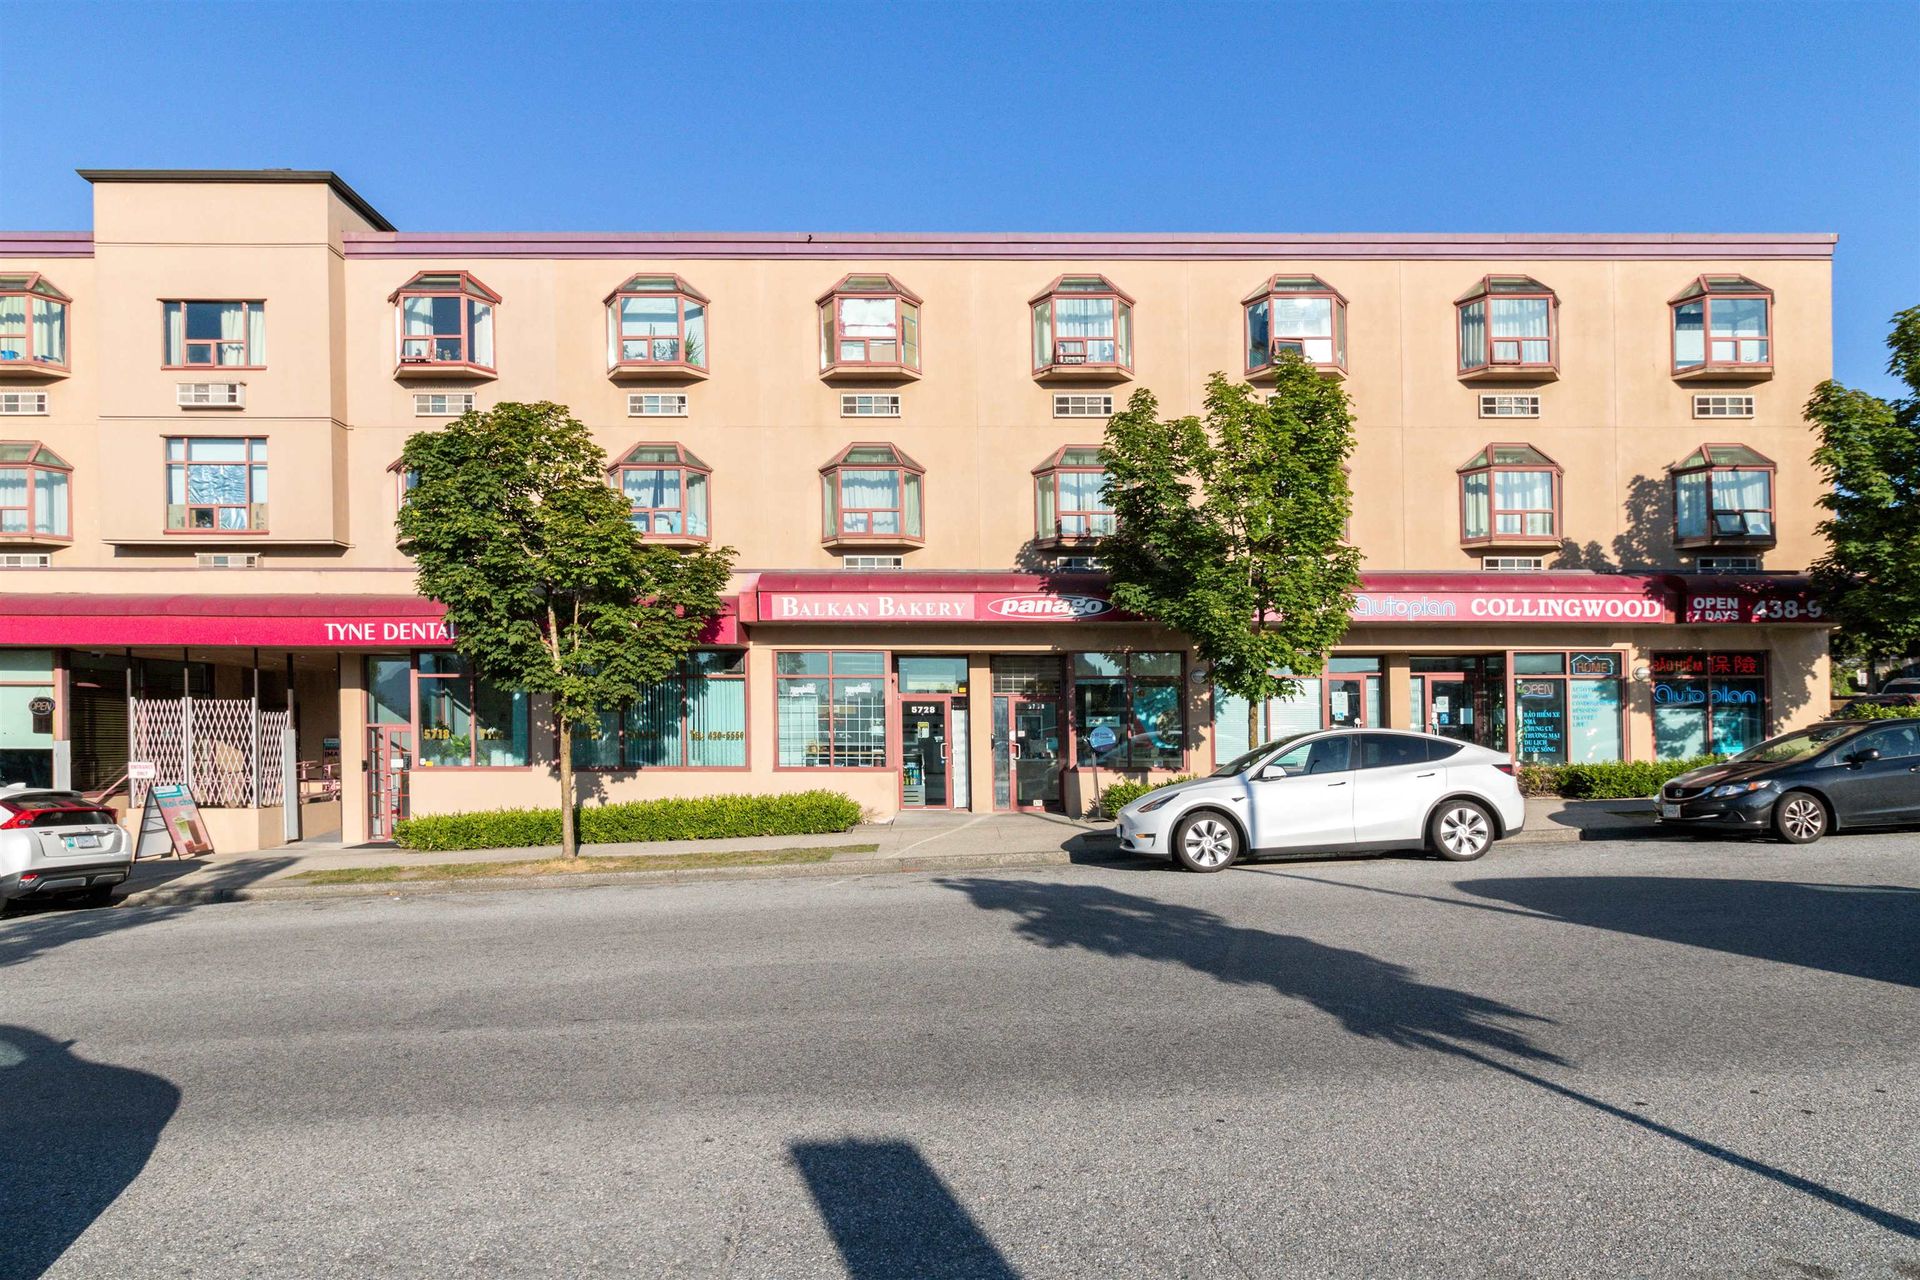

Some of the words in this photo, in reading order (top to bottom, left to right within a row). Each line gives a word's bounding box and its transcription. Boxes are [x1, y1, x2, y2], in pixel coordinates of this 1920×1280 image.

[781, 596, 869, 617] BALKAN
[878, 596, 966, 617] BAKERY
[1000, 597, 1103, 615] panago
[1354, 594, 1456, 621] Autoplan
[1471, 598, 1661, 618] COLLINGWOOD
[1693, 597, 1739, 610] OPEN
[1693, 610, 1703, 621] 7
[1705, 610, 1739, 621] DAYS
[324, 622, 376, 641] TYNE
[383, 622, 458, 640] DENTAL
[1576, 662, 1608, 673] HOME
[1521, 683, 1554, 695] OPEN
[911, 706, 936, 714] 5728
[423, 728, 449, 740] 5718
